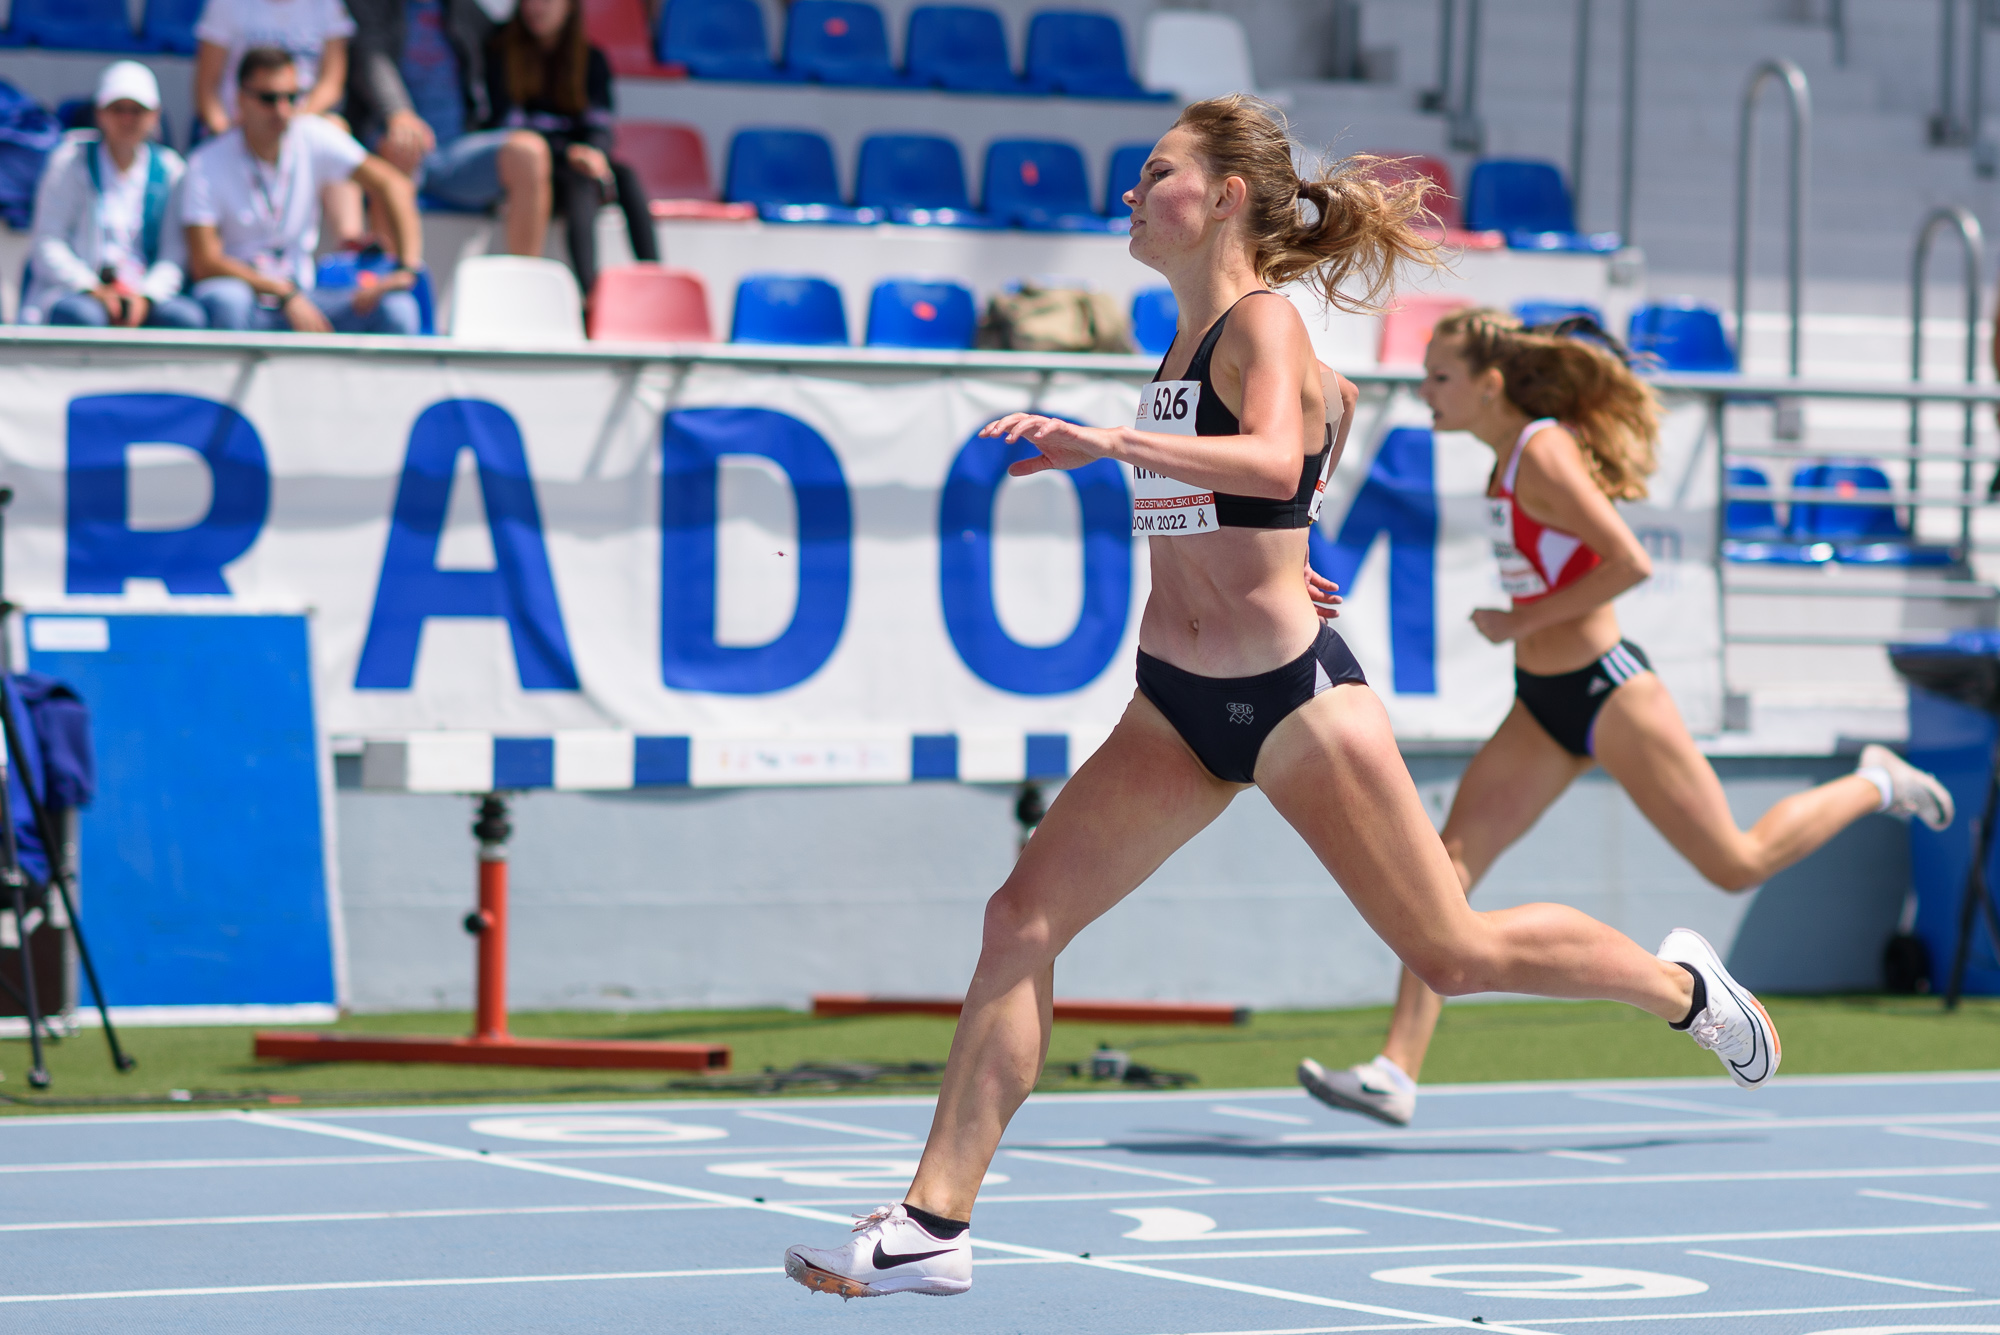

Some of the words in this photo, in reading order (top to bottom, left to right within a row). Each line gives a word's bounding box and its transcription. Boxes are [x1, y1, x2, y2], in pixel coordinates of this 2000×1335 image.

[1153, 386, 1190, 421] 626
[1191, 495, 1211, 505] U20
[1156, 513, 1188, 531] 2022
